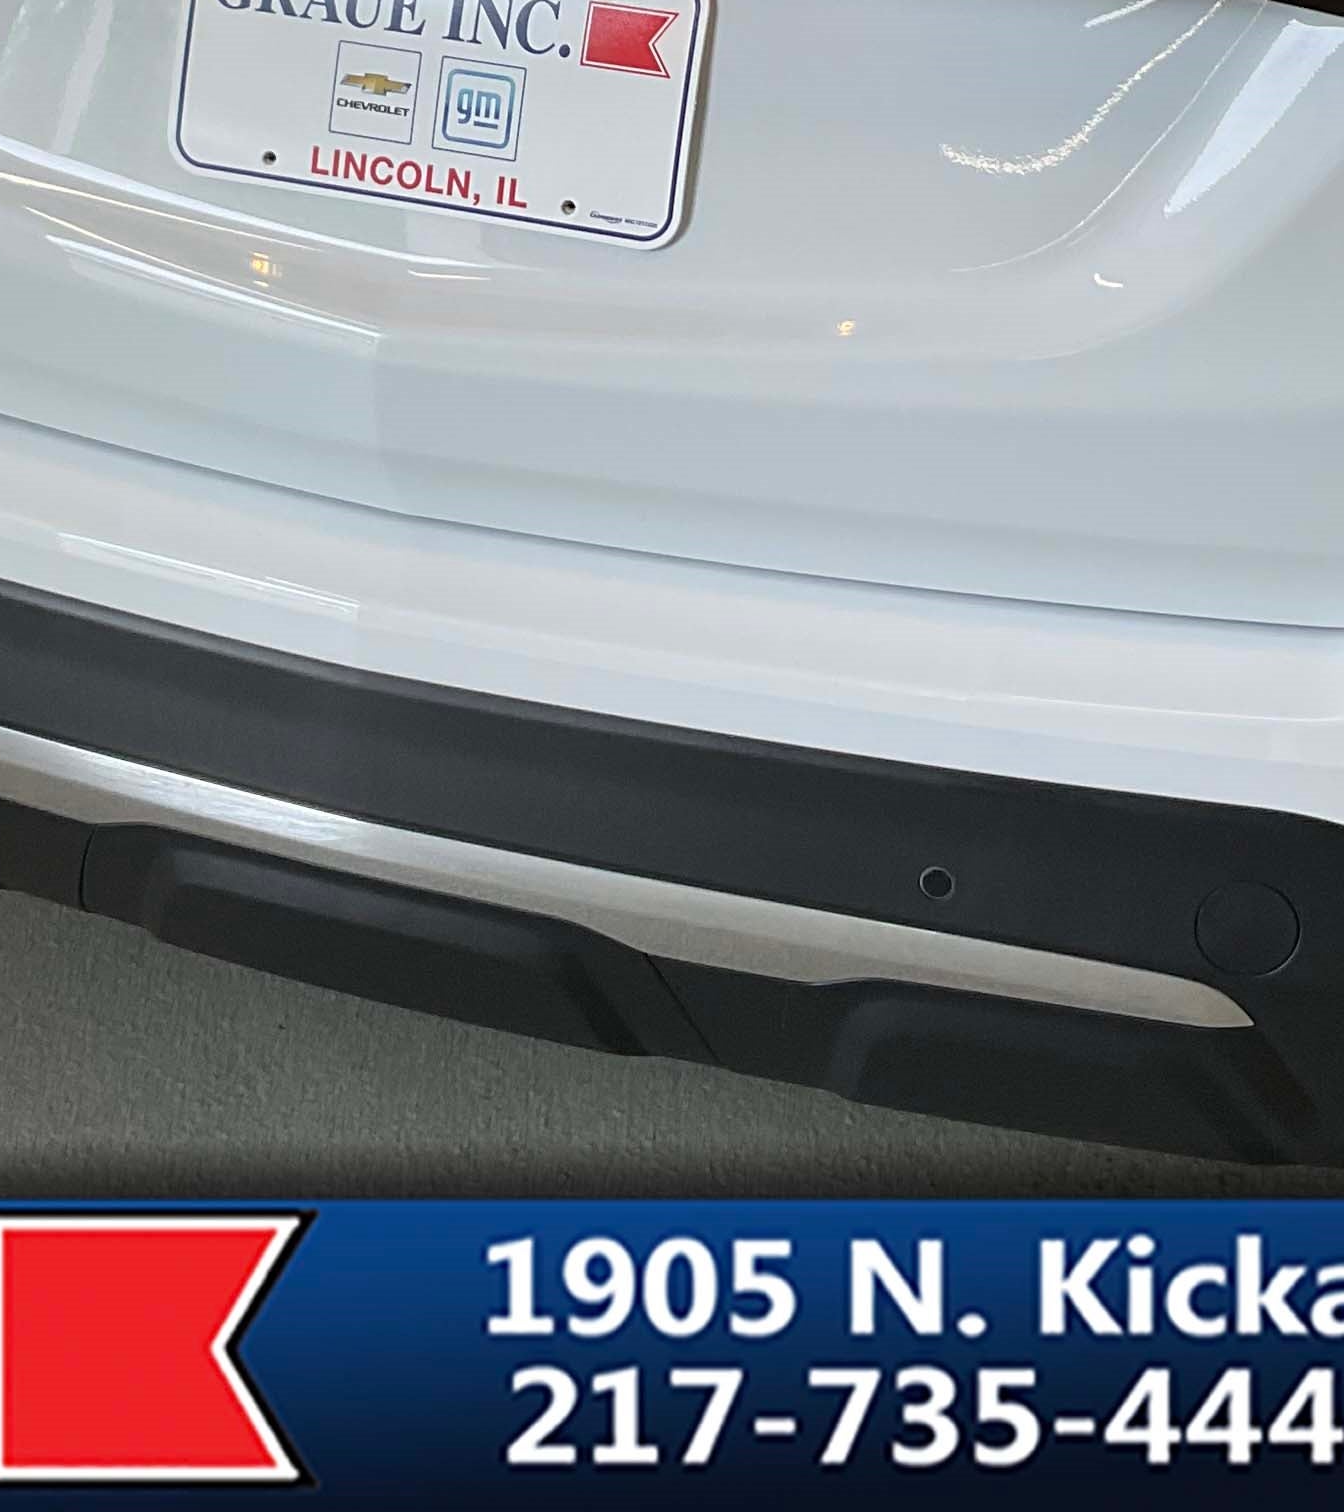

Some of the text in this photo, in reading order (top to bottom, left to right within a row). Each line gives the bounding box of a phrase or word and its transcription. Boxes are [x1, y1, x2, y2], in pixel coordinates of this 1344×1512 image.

[336, 97, 411, 117] CHEVROLET
[456, 87, 502, 130] gm
[310, 145, 528, 209] LINCOLN, IL
